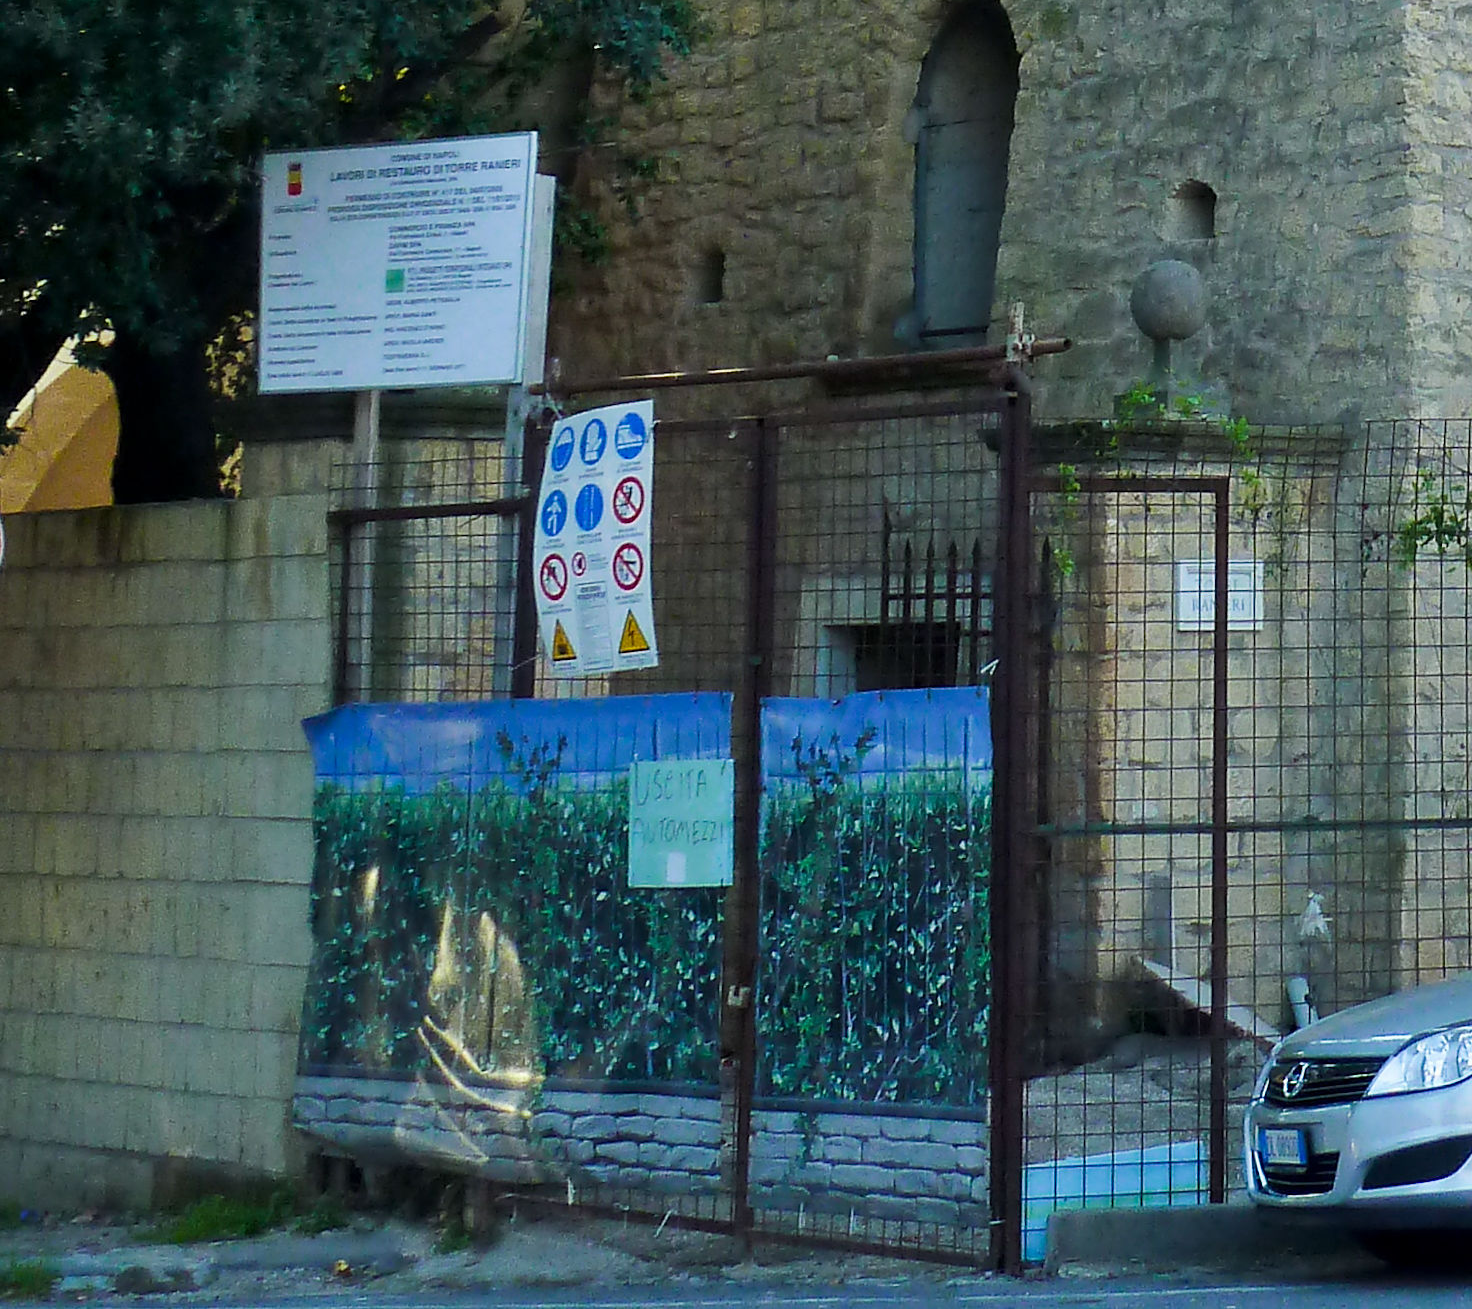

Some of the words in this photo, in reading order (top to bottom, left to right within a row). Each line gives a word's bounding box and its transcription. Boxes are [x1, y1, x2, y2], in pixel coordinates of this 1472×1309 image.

[330, 169, 364, 182] LAVORI
[366, 168, 376, 179] DI
[379, 164, 430, 178] RESTAURO
[433, 163, 443, 174] DI
[444, 161, 478, 173] TORRE
[480, 157, 521, 170] RANIERI
[631, 816, 724, 847] AUTOMEZZI
